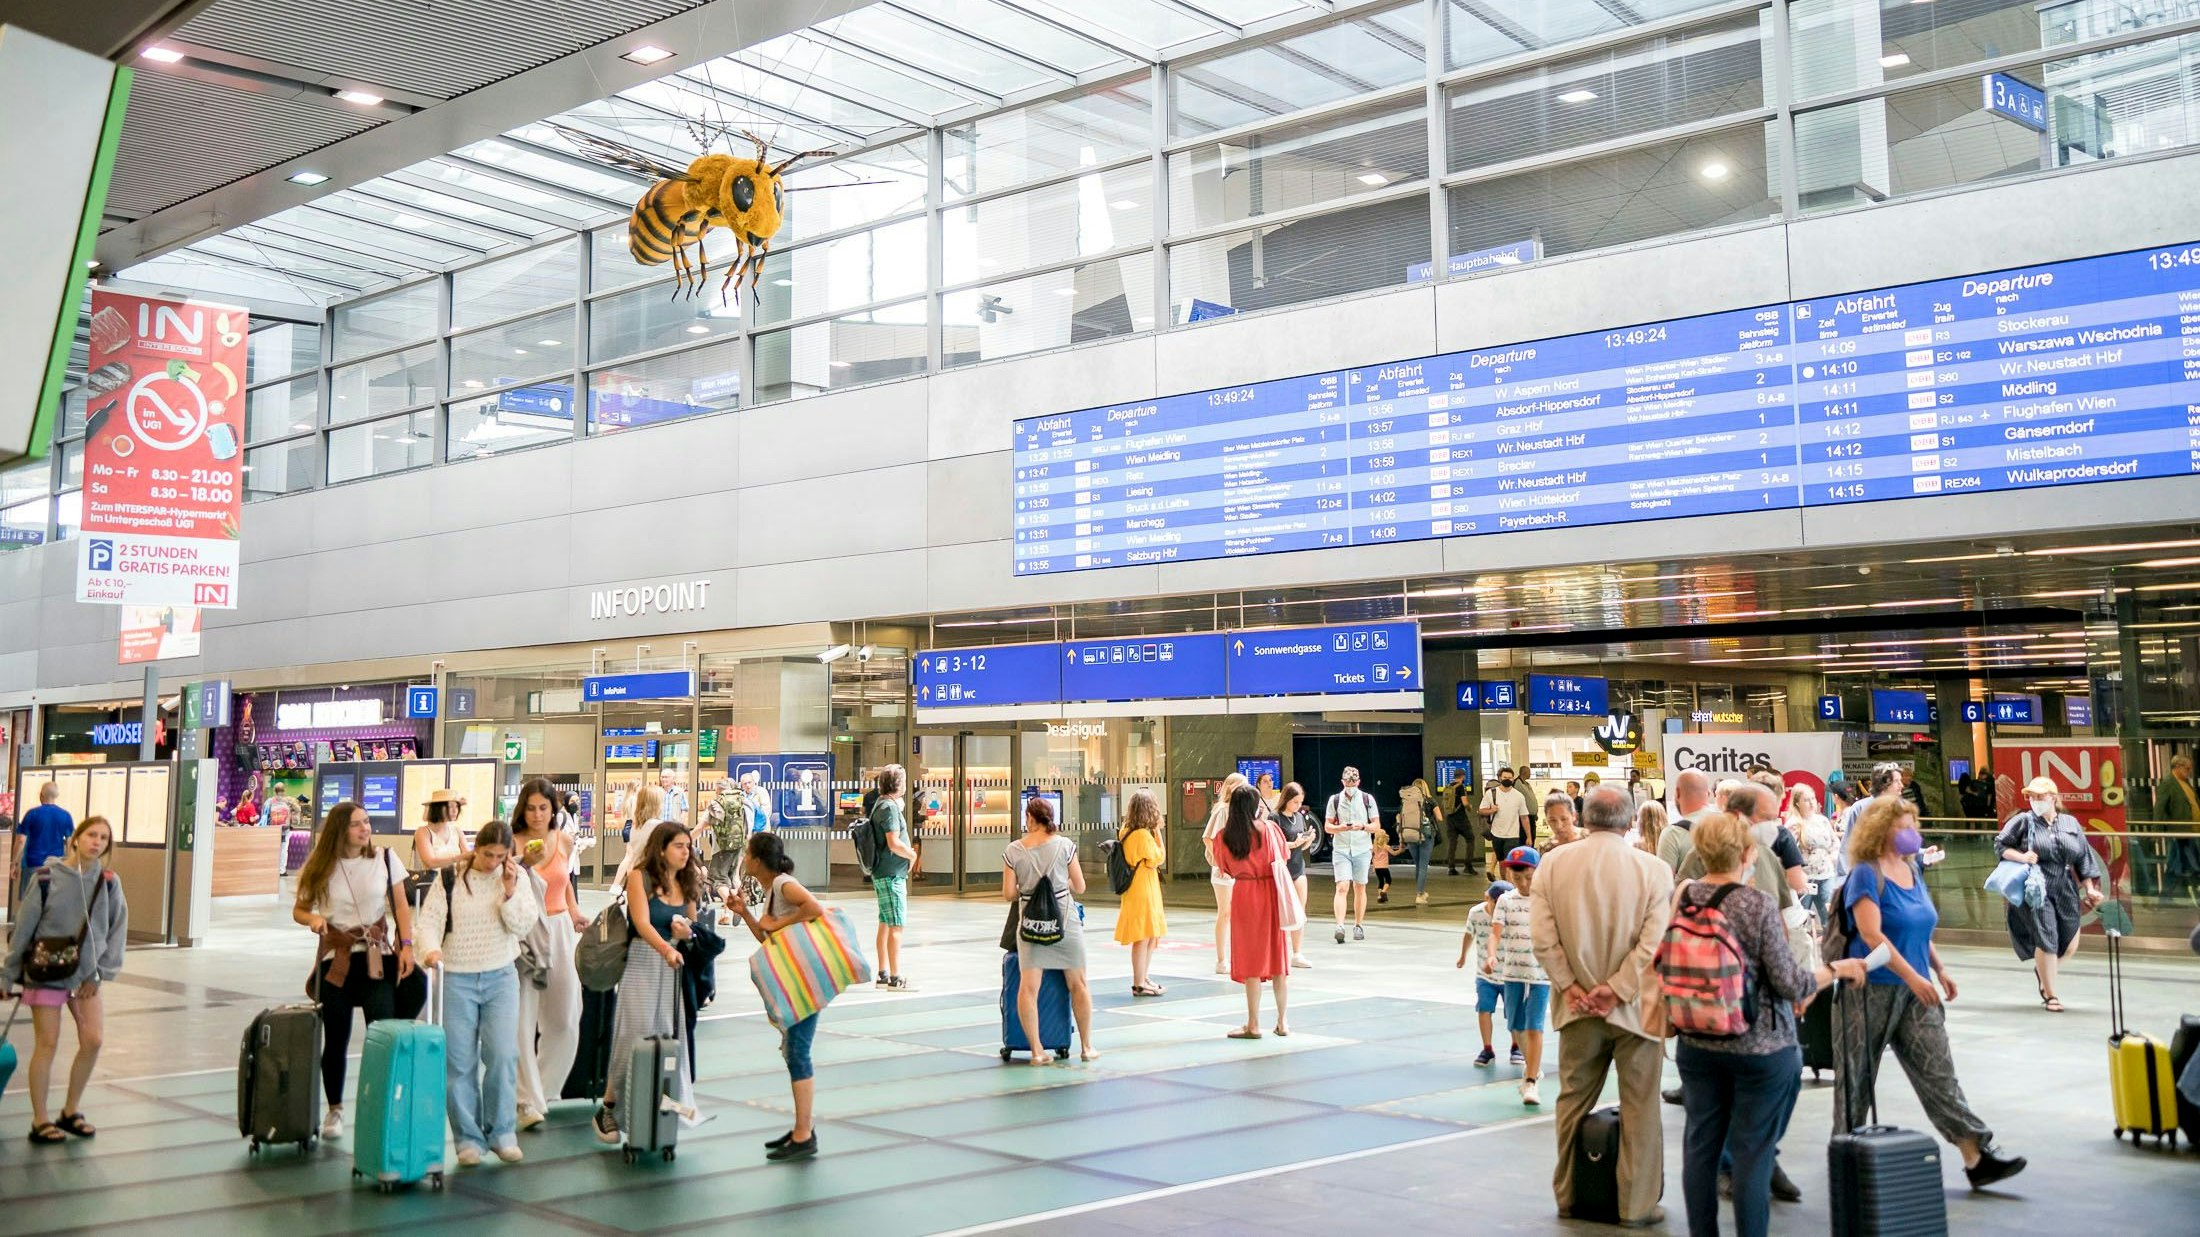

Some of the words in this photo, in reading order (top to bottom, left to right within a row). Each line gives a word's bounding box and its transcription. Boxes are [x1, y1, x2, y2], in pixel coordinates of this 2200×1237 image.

[1996, 82, 2006, 106] 3
[2008, 94, 2016, 111] A
[1834, 294, 1896, 315] Abfahrt
[1962, 273, 2054, 297] Departure
[138, 302, 204, 344] IN
[1818, 319, 1835, 328] Zeit
[1862, 310, 1898, 322] Erwartet
[1933, 303, 1952, 314] Zug
[1996, 293, 2019, 304] nach
[1862, 320, 1907, 334] estimated
[1935, 313, 1955, 324] train
[1996, 306, 2007, 316] to
[1740, 340, 1773, 352] platform
[1821, 340, 1856, 356] 14:09
[1935, 331, 1950, 341] R3
[1997, 315, 2070, 333] Stockerau
[1821, 361, 1858, 377] 14:10
[1936, 352, 1953, 362] EC
[1956, 350, 1972, 360] 102
[1998, 334, 2074, 354] Warszawa
[2077, 322, 2163, 345] Wschodnia
[1378, 363, 1422, 381] Abfahrt
[1470, 347, 1537, 368] Departure
[1605, 327, 1667, 348] 13:49:24
[1449, 372, 1463, 382] Zug
[1739, 327, 1779, 339] Bahnsteig
[1367, 403, 1393, 416] 13:56
[1514, 382, 1551, 397] Aspern
[1554, 378, 1579, 391] Nord
[1755, 354, 1763, 365] 3
[1822, 382, 1857, 396] 14:11
[2000, 353, 2093, 376] Wr.Neustadt
[2096, 348, 2124, 364] Hbf
[143, 408, 155, 418] im
[1037, 417, 1071, 433] Abfahrt
[1107, 405, 1157, 422] Departure
[1208, 387, 1255, 407] 13:49:24
[1367, 421, 1393, 434] 13:57
[1496, 395, 1601, 418] Absdorf-Hippersdorf
[1756, 373, 1765, 385] 2
[1823, 402, 1858, 417] 14:11
[1939, 393, 1954, 405] S2
[2002, 380, 2057, 398] Mödling
[143, 420, 161, 430] UG1
[1497, 424, 1521, 436] Graz
[1525, 421, 1543, 432] Hbf
[1824, 422, 1861, 437] 14:12
[1940, 414, 1955, 425] RJ
[2003, 399, 2073, 420] Flughafen
[2076, 396, 2117, 412] Wien
[1126, 436, 1164, 450] Flughafen
[1166, 433, 1186, 443] Wien
[1368, 456, 1394, 469] 13:59
[1452, 449, 1473, 458] REX1
[1497, 437, 1563, 454] Wr.Neustadt
[1566, 434, 1586, 446] Hbf
[1759, 413, 1765, 424] 1
[1826, 443, 1862, 458] 14:12
[1941, 436, 1956, 447] S1
[2004, 419, 2095, 440] Gänserndorf
[1028, 467, 1049, 478] 13:47
[1092, 462, 1100, 470] S1
[1126, 455, 1147, 466] Wien
[1148, 450, 1181, 463] Meidling
[1320, 430, 1325, 440] 1
[1368, 474, 1395, 486] 14:00
[1759, 433, 1768, 444] 2
[1827, 463, 1863, 478] 14:15
[1943, 458, 1958, 468] S2
[2006, 443, 2083, 462] Mistelbach
[93, 464, 113, 476] Mo
[127, 467, 139, 478] Fr
[152, 468, 178, 480] 8.30
[191, 469, 233, 485] 21.00
[1126, 486, 1153, 498] Liesing
[1321, 464, 1326, 474] 1
[1369, 491, 1396, 504] 14:02
[1498, 475, 1565, 491] Wr.Neustadt
[1567, 471, 1588, 483] Hbf
[1761, 452, 1767, 464] 1
[1827, 484, 1865, 499] 14:15
[1944, 476, 1982, 489] REX64
[2007, 459, 2138, 483] Wulkaprodersdorf
[91, 482, 108, 494] Sa
[150, 486, 177, 499] 8.30
[190, 487, 233, 503] 18.00
[1498, 498, 1526, 509] Wien
[1529, 491, 1581, 506] Hütteldorf
[1761, 473, 1769, 484] 3
[1771, 473, 1789, 483] A-B
[90, 501, 114, 512] Zum
[114, 503, 228, 520] INTERSPAR-Hypermarkt
[104, 514, 173, 528] Untergeschoß
[176, 519, 195, 529] UG1
[1028, 530, 1048, 541] 13:51
[1126, 518, 1165, 530] Marchegg
[1317, 499, 1328, 509] 12
[1370, 527, 1397, 540] 14:08
[1454, 522, 1476, 531] REX3
[1499, 511, 1569, 529] Payerbach-R.
[1762, 492, 1769, 504] 1
[93, 549, 110, 569] P
[120, 544, 128, 556] 2
[131, 545, 198, 560] STUNDEN
[1127, 549, 1160, 562] Salzburg
[1162, 547, 1178, 558] Hbf
[1322, 533, 1328, 543] 7
[87, 578, 102, 587] Ab
[104, 578, 112, 587] €
[119, 561, 169, 574] GRATIS
[172, 563, 230, 577] PARKEN!
[87, 589, 125, 600] Einkauf
[197, 585, 226, 603] IN
[591, 580, 711, 620] INFOPOINT
[1254, 642, 1322, 656] Sonnwendgasse
[603, 687, 626, 695] InfoPoint
[1334, 673, 1365, 684] Tickets
[963, 689, 976, 699] WC
[1462, 687, 1474, 705] 4
[1575, 700, 1591, 711] 3-4
[1825, 701, 1833, 716] 5
[1903, 710, 1914, 720] 5-6
[1967, 705, 1976, 719] 6
[1674, 747, 1770, 773] Caritas
[2021, 750, 2091, 789] IN
